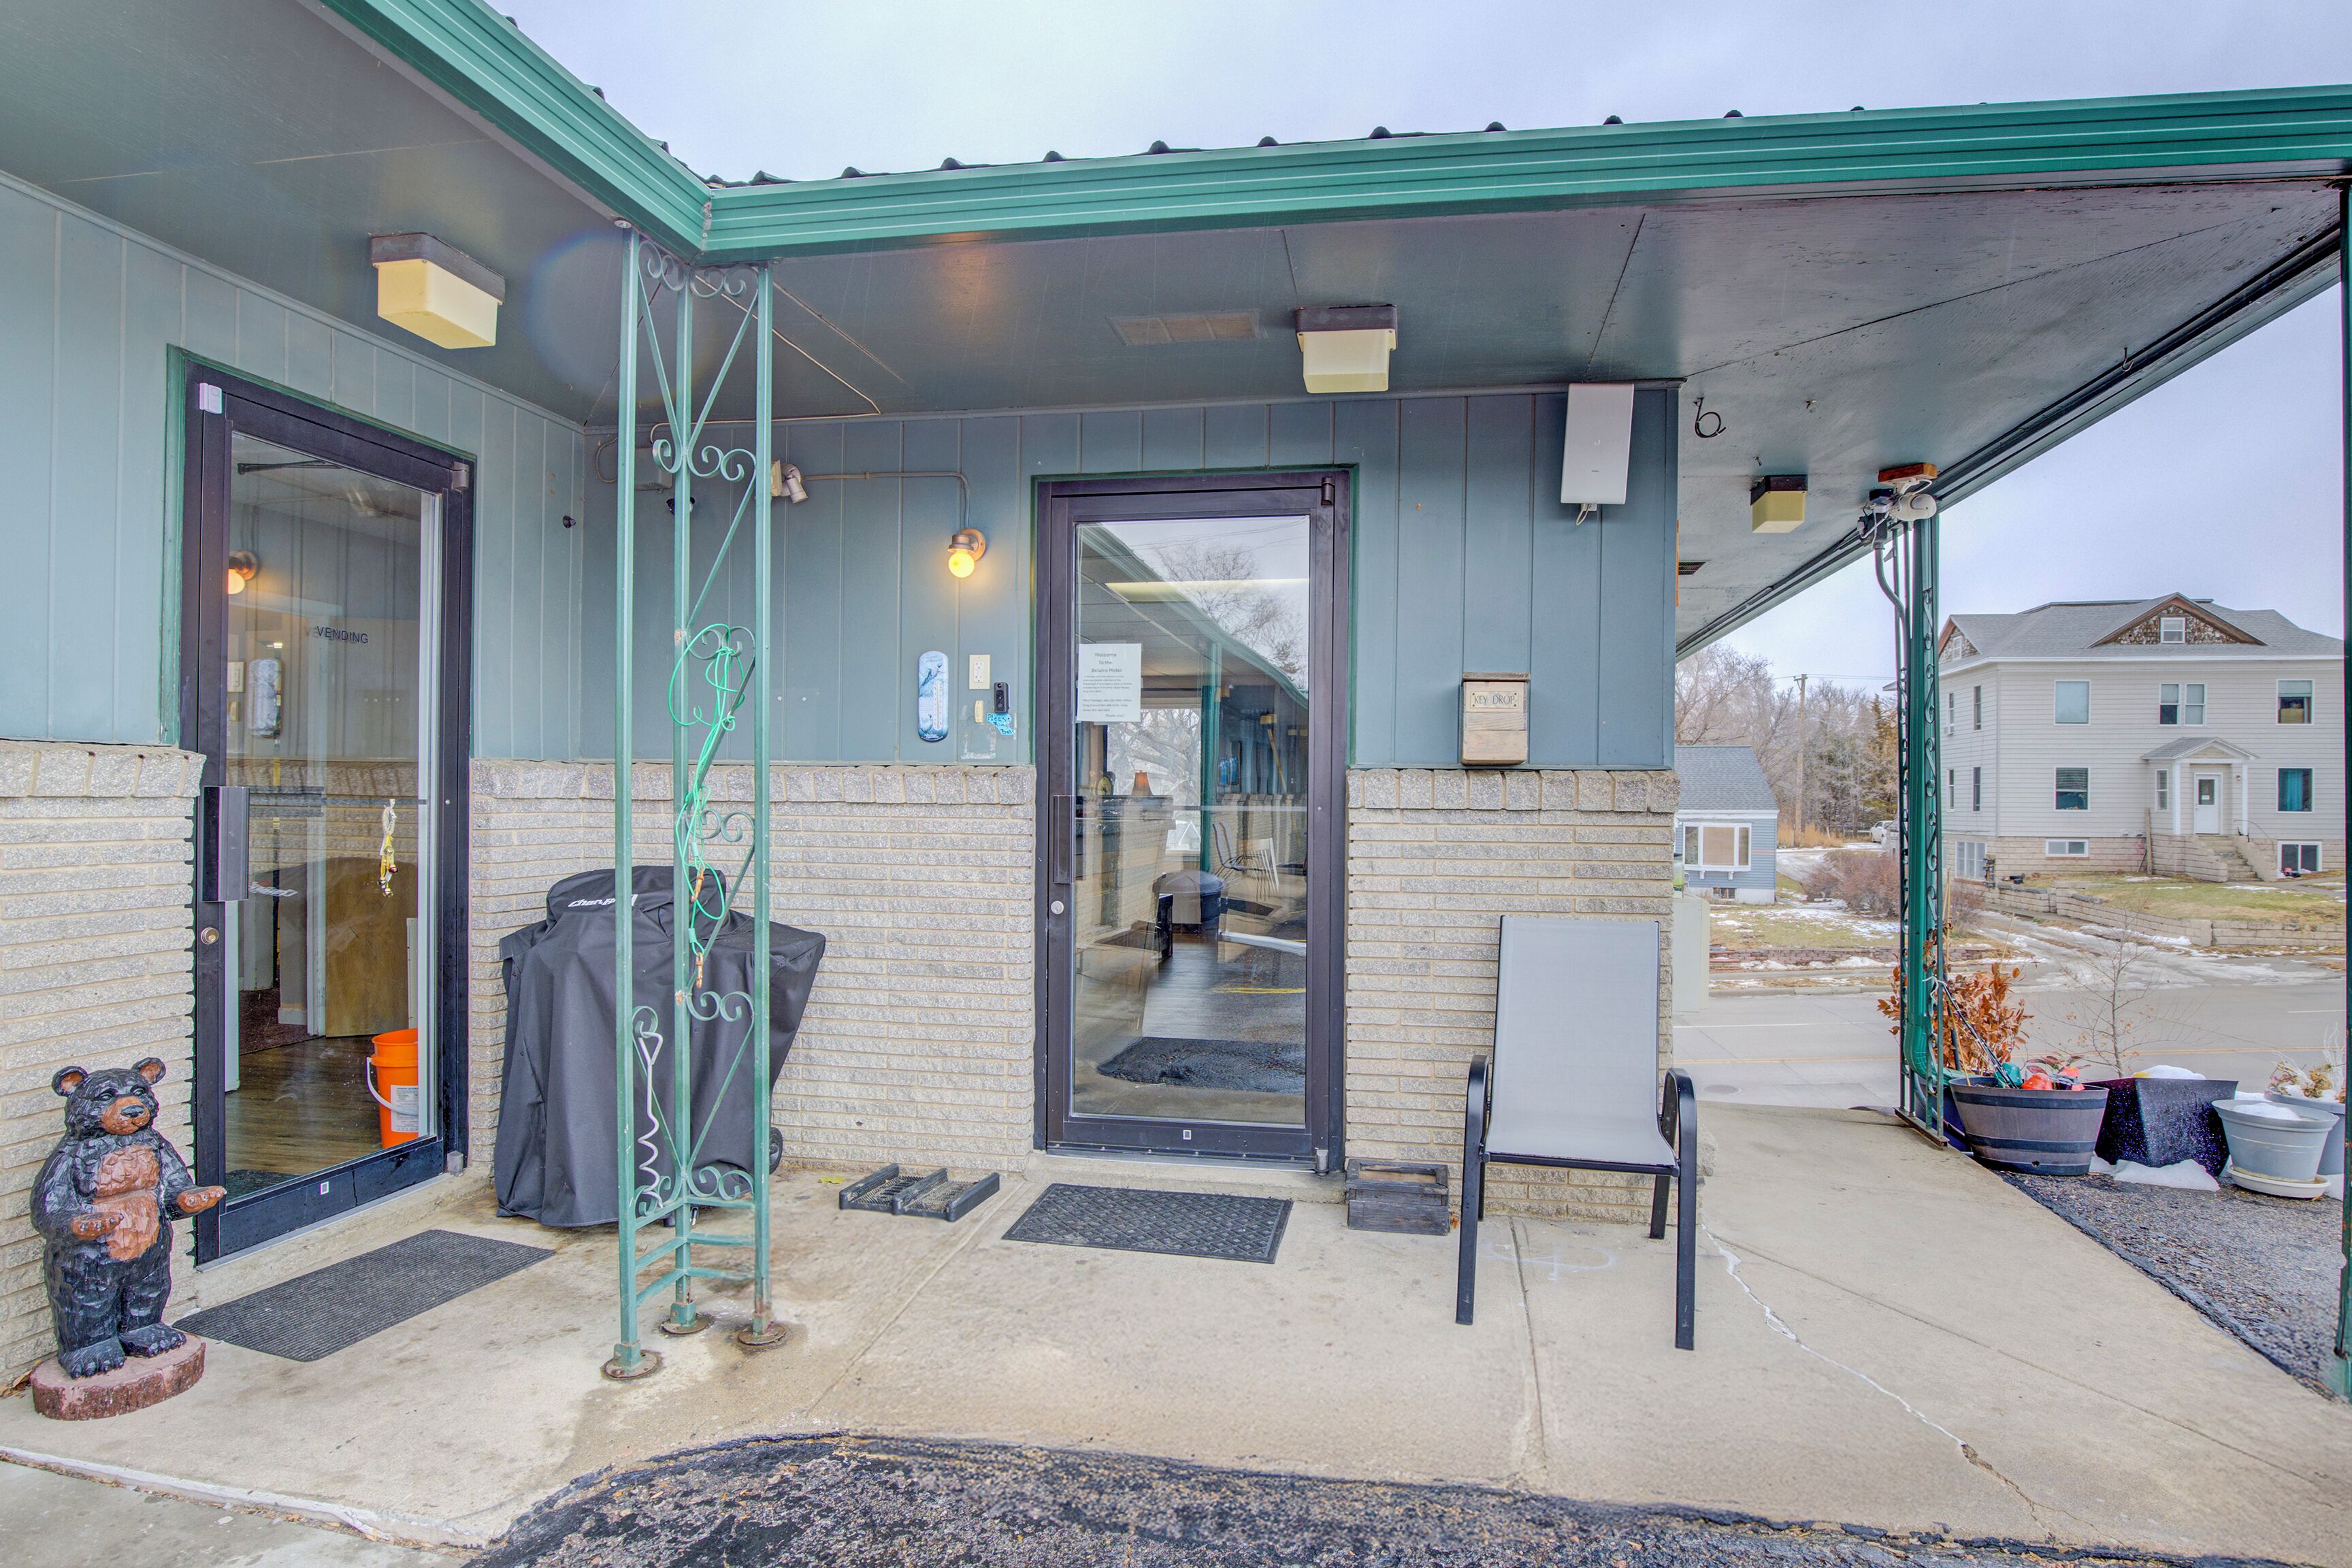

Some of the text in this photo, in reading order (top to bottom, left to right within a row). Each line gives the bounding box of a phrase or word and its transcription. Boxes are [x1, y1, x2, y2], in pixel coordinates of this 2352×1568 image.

[316, 625, 368, 644] VENDING
[1474, 695, 1515, 704] KEY DROP
